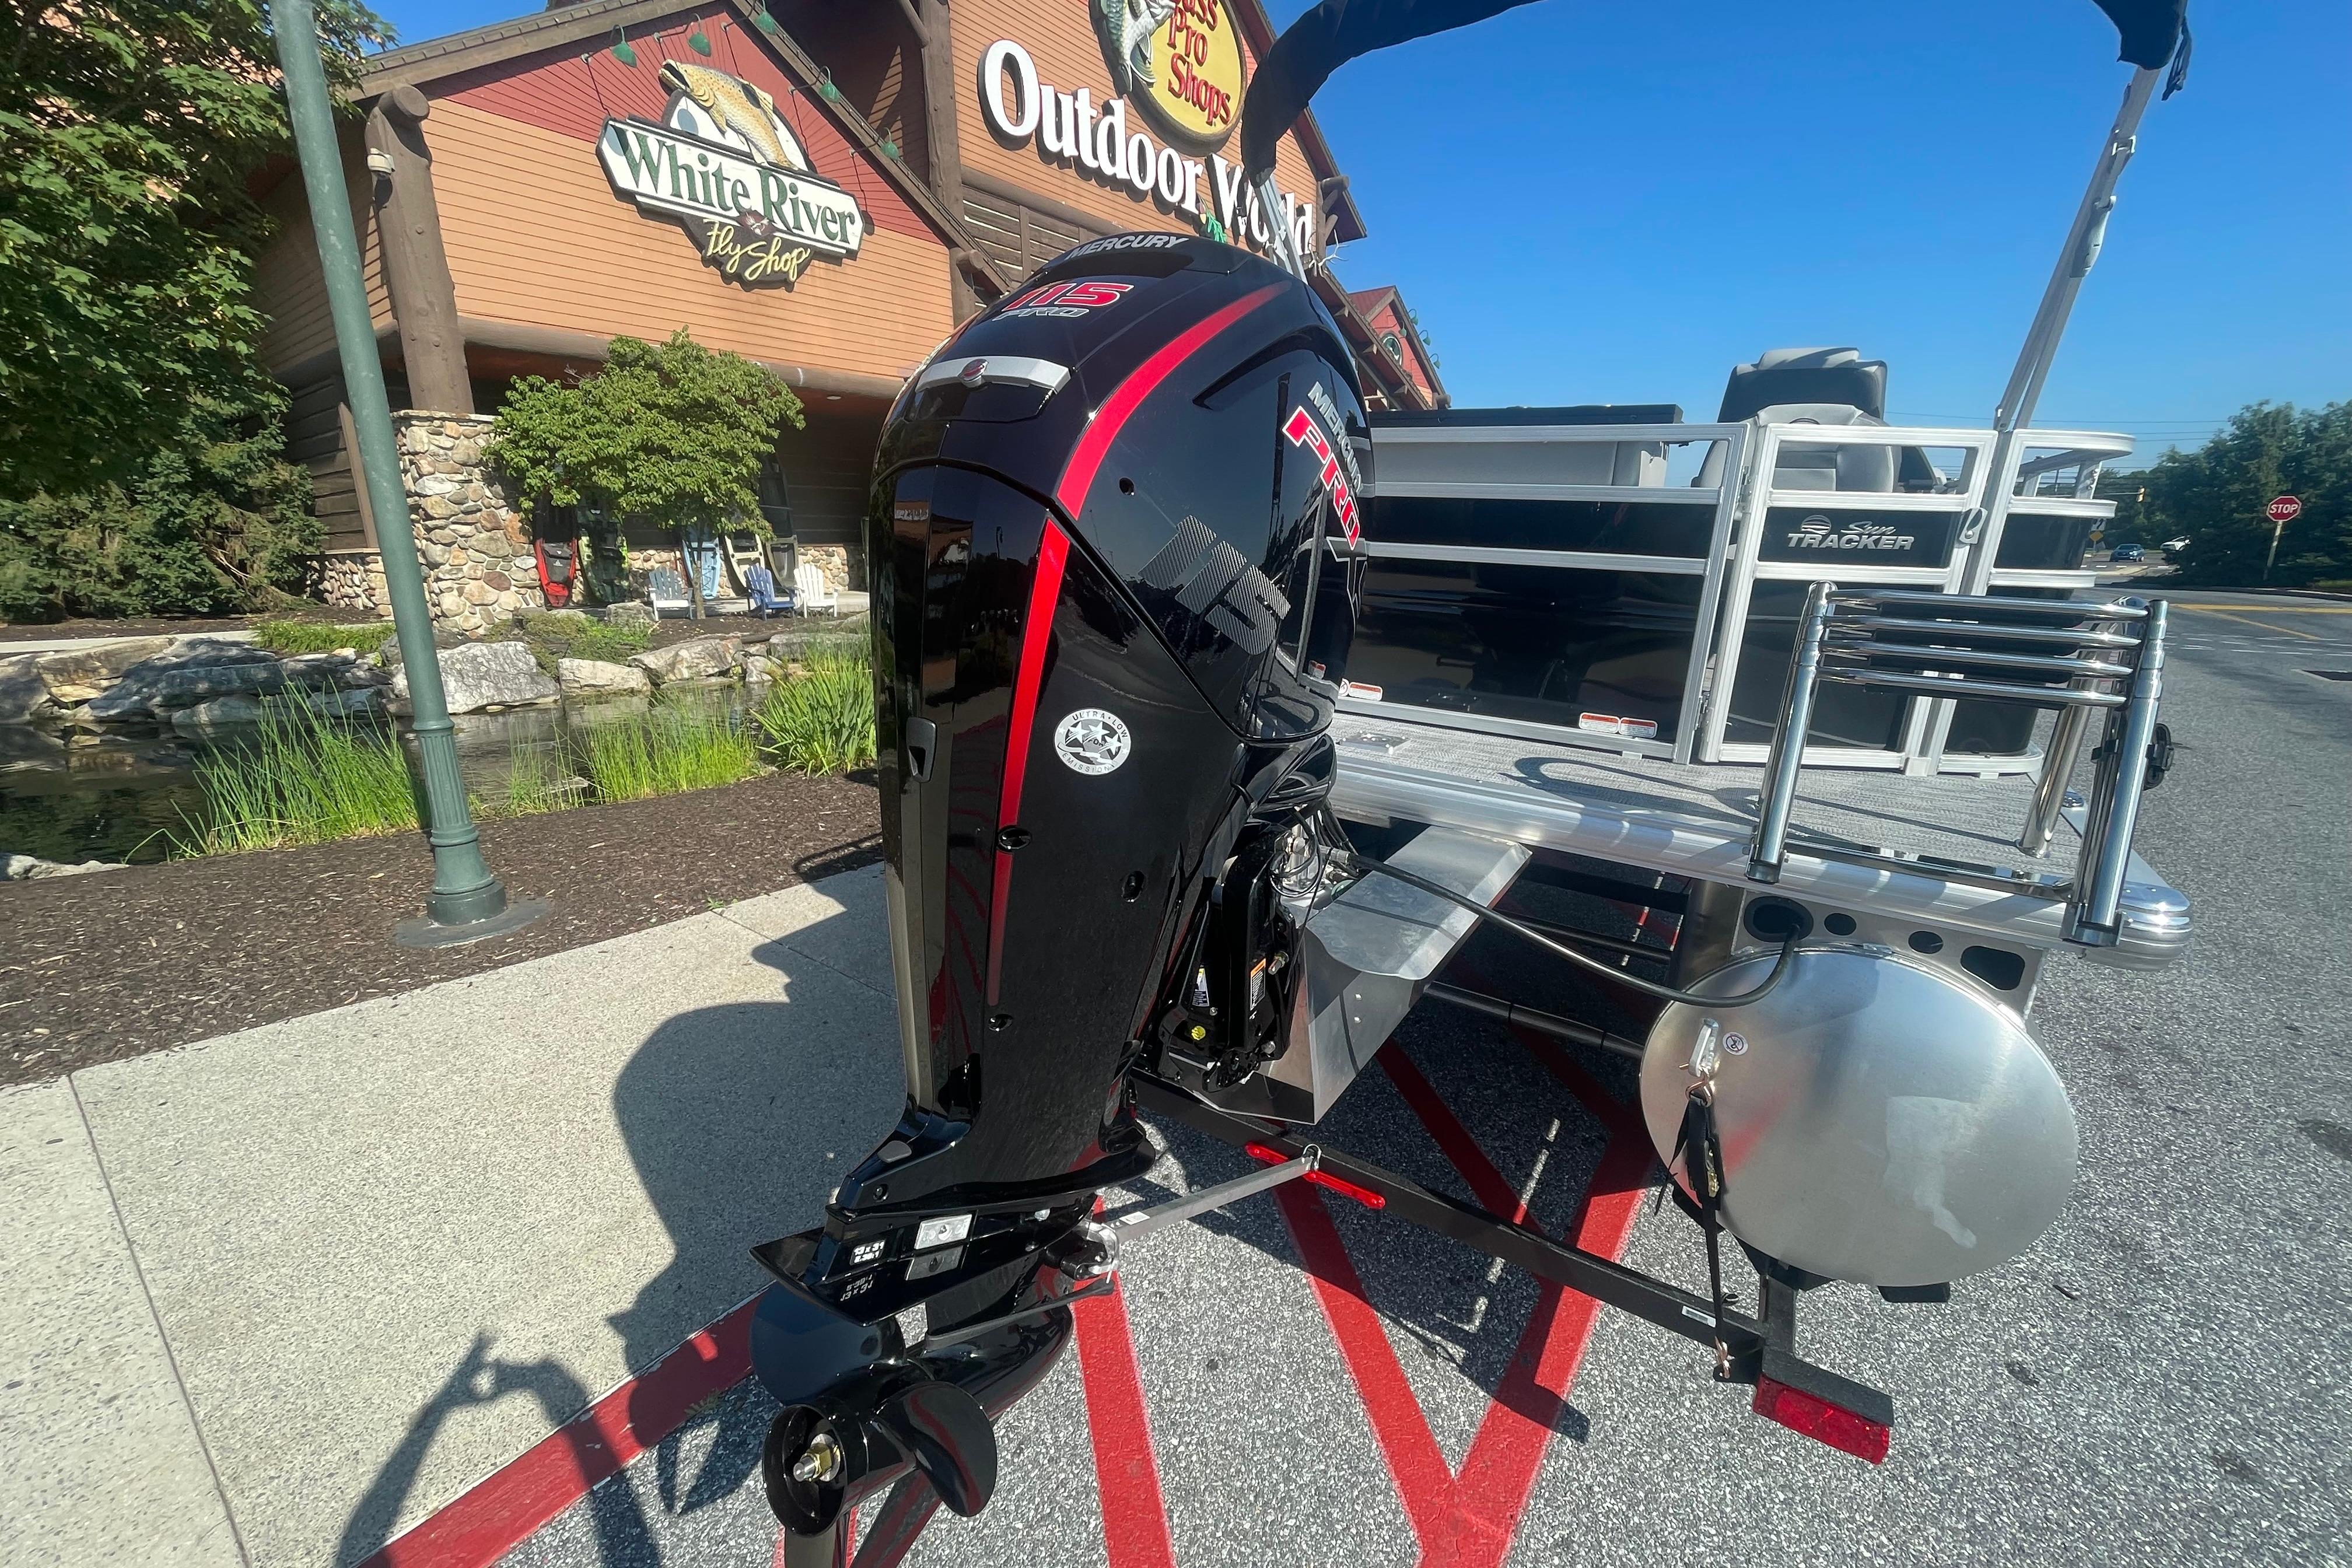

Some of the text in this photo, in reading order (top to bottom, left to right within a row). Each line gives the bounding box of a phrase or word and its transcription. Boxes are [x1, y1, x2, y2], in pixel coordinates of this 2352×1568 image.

[1170, 0, 1218, 31] ass
[1167, 5, 1208, 66] Pro
[1168, 53, 1231, 126] Shops
[984, 40, 1312, 256] Outdoor Wold
[620, 130, 855, 244] White River
[703, 218, 811, 281] Fly Shop
[1064, 235, 1189, 261] MERCURY
[1001, 282, 1135, 312] 115
[992, 307, 1089, 321] PRO
[1282, 405, 1360, 550] PRO
[2269, 504, 2298, 513] STOP
[1787, 533, 1915, 551] TRACKER
[1840, 520, 1897, 535] Sun
[1138, 514, 1292, 655] 115
[1072, 710, 1129, 738] ULTRA LOW
